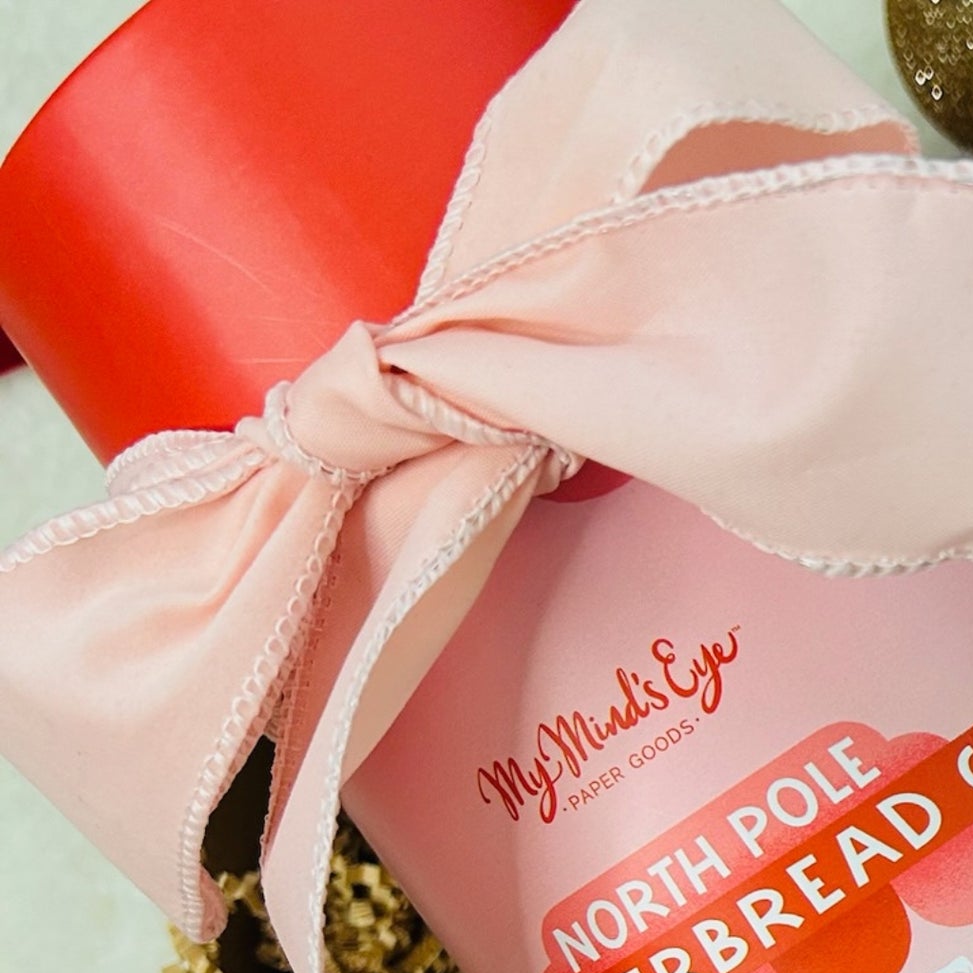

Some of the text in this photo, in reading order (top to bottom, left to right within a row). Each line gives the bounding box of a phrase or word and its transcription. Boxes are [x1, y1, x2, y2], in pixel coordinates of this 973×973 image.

[477, 757, 563, 824] My
[537, 667, 669, 778] Mind's
[726, 736, 881, 859] POLE
